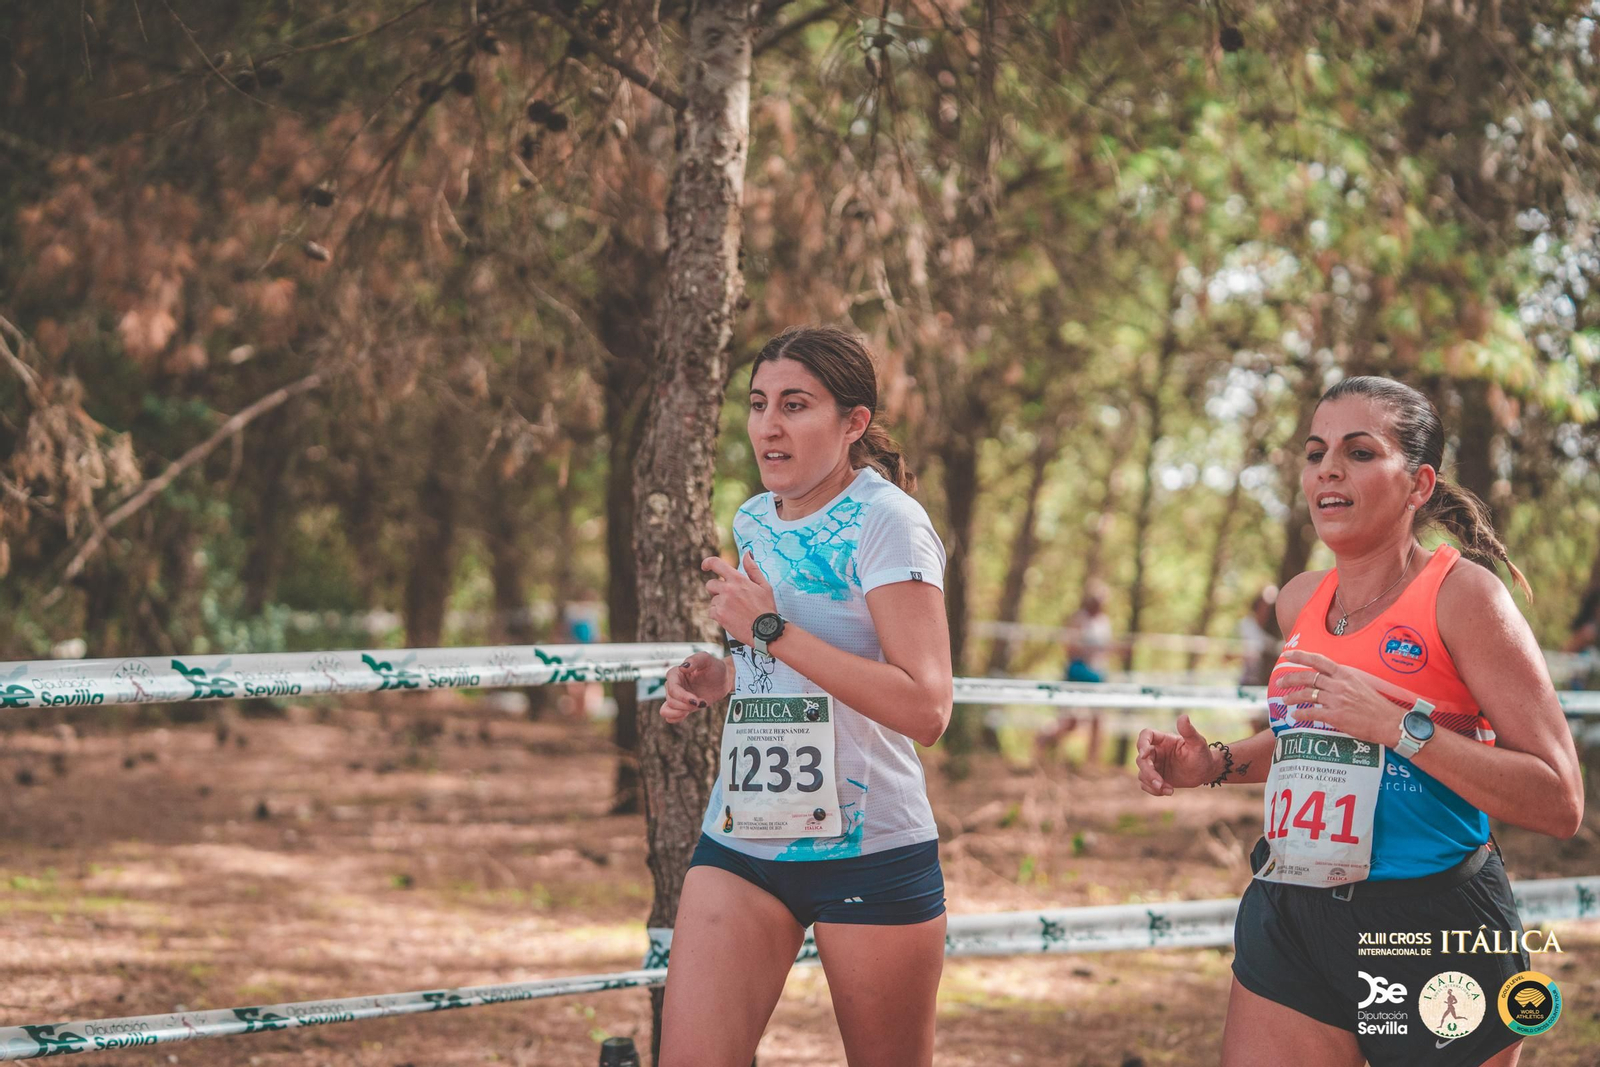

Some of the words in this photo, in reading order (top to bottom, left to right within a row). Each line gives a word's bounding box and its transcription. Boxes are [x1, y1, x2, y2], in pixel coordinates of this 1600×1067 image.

[244, 680, 302, 698] Sevilla
[428, 671, 481, 688] Sevilla
[39, 689, 105, 708] Sevilla
[745, 699, 793, 718] ITÁLICA
[1284, 735, 1341, 758] ITÁLICA
[728, 746, 824, 792] 1233
[1316, 767, 1347, 776] ROMERO
[1314, 775, 1346, 783] ALCORES
[1268, 788, 1359, 845] 1241
[94, 1032, 158, 1051] Sevilla
